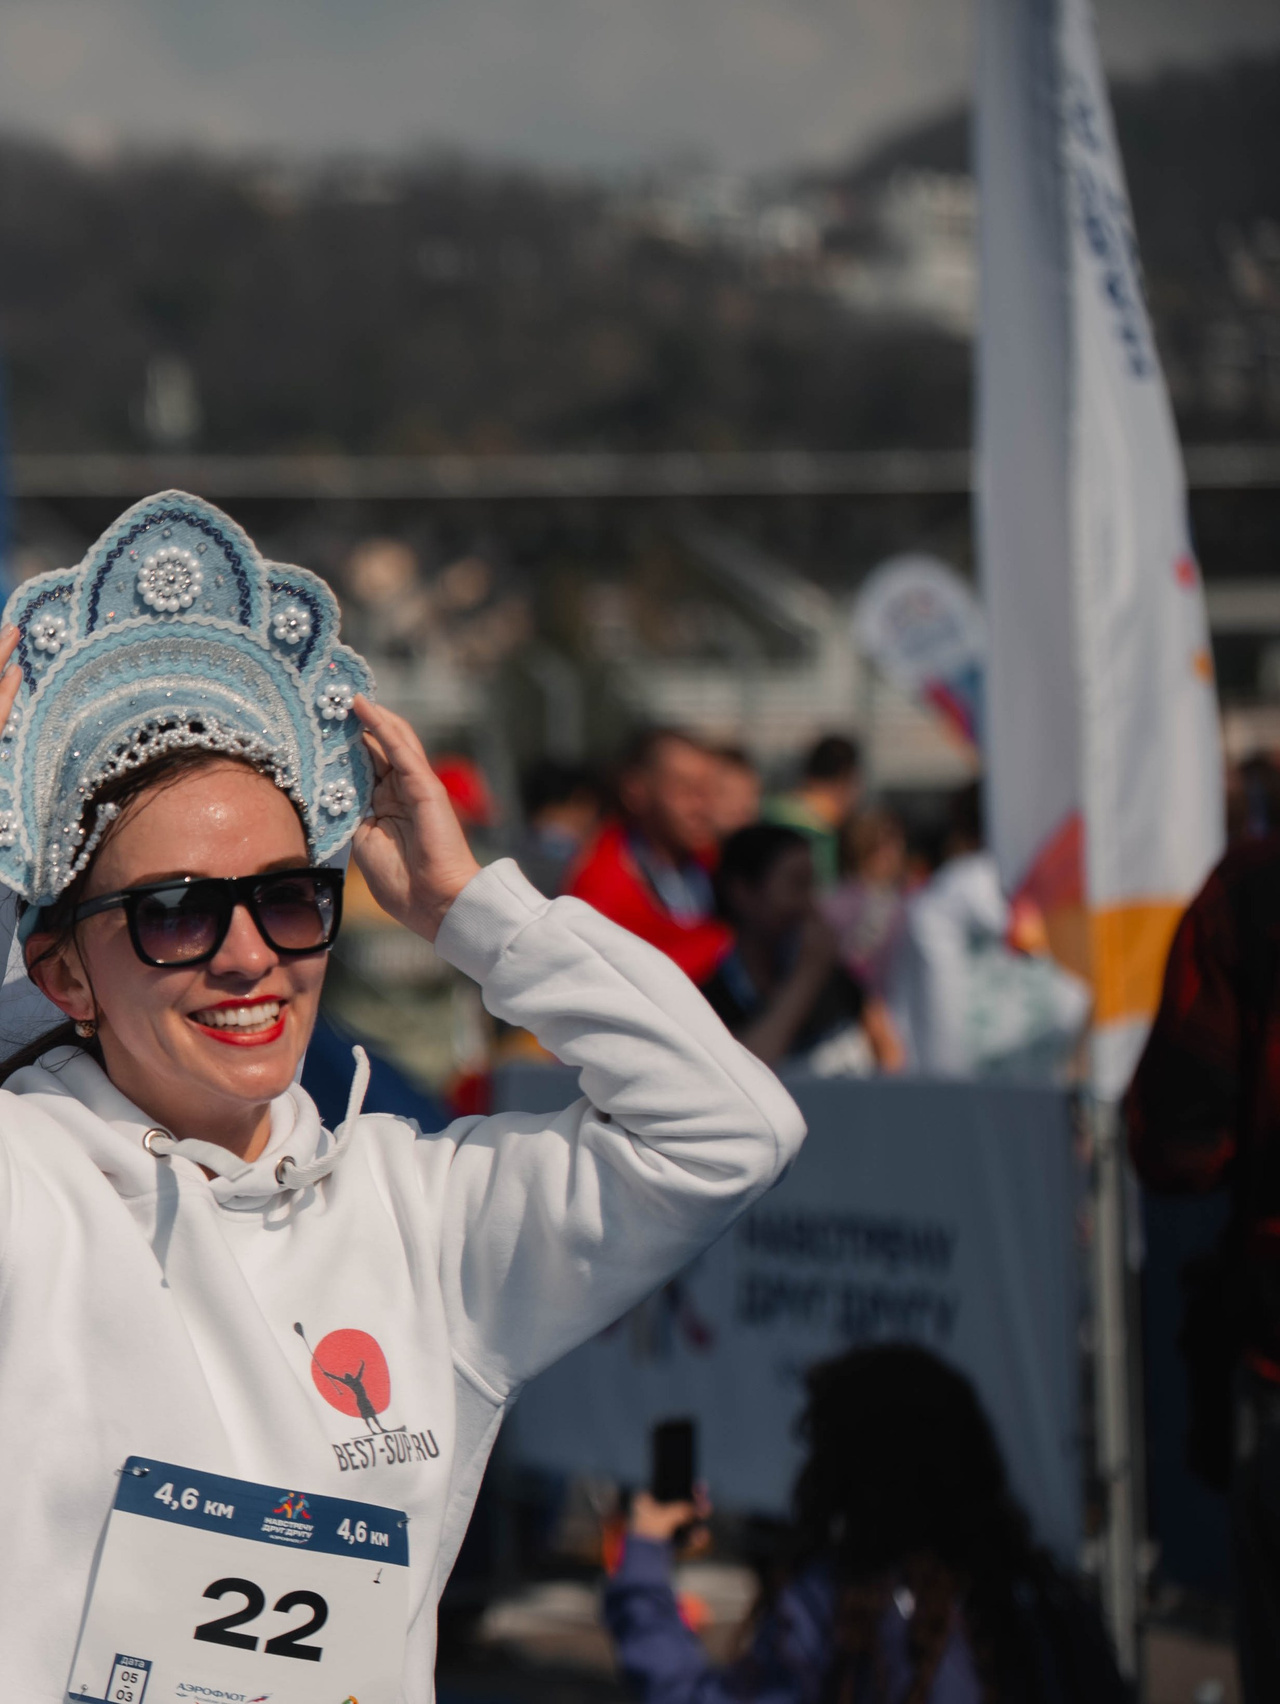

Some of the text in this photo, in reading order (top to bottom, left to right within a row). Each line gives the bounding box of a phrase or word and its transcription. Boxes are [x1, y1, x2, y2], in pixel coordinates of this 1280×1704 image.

[153, 1482, 200, 1511] 4,6
[336, 1518, 368, 1545] 4,6
[193, 1577, 329, 1662] 22
[120, 1656, 145, 1668] дата
[121, 1671, 139, 1684] 05
[116, 1689, 134, 1703] 03
[176, 1682, 247, 1702] АЭРОФЛОТ
